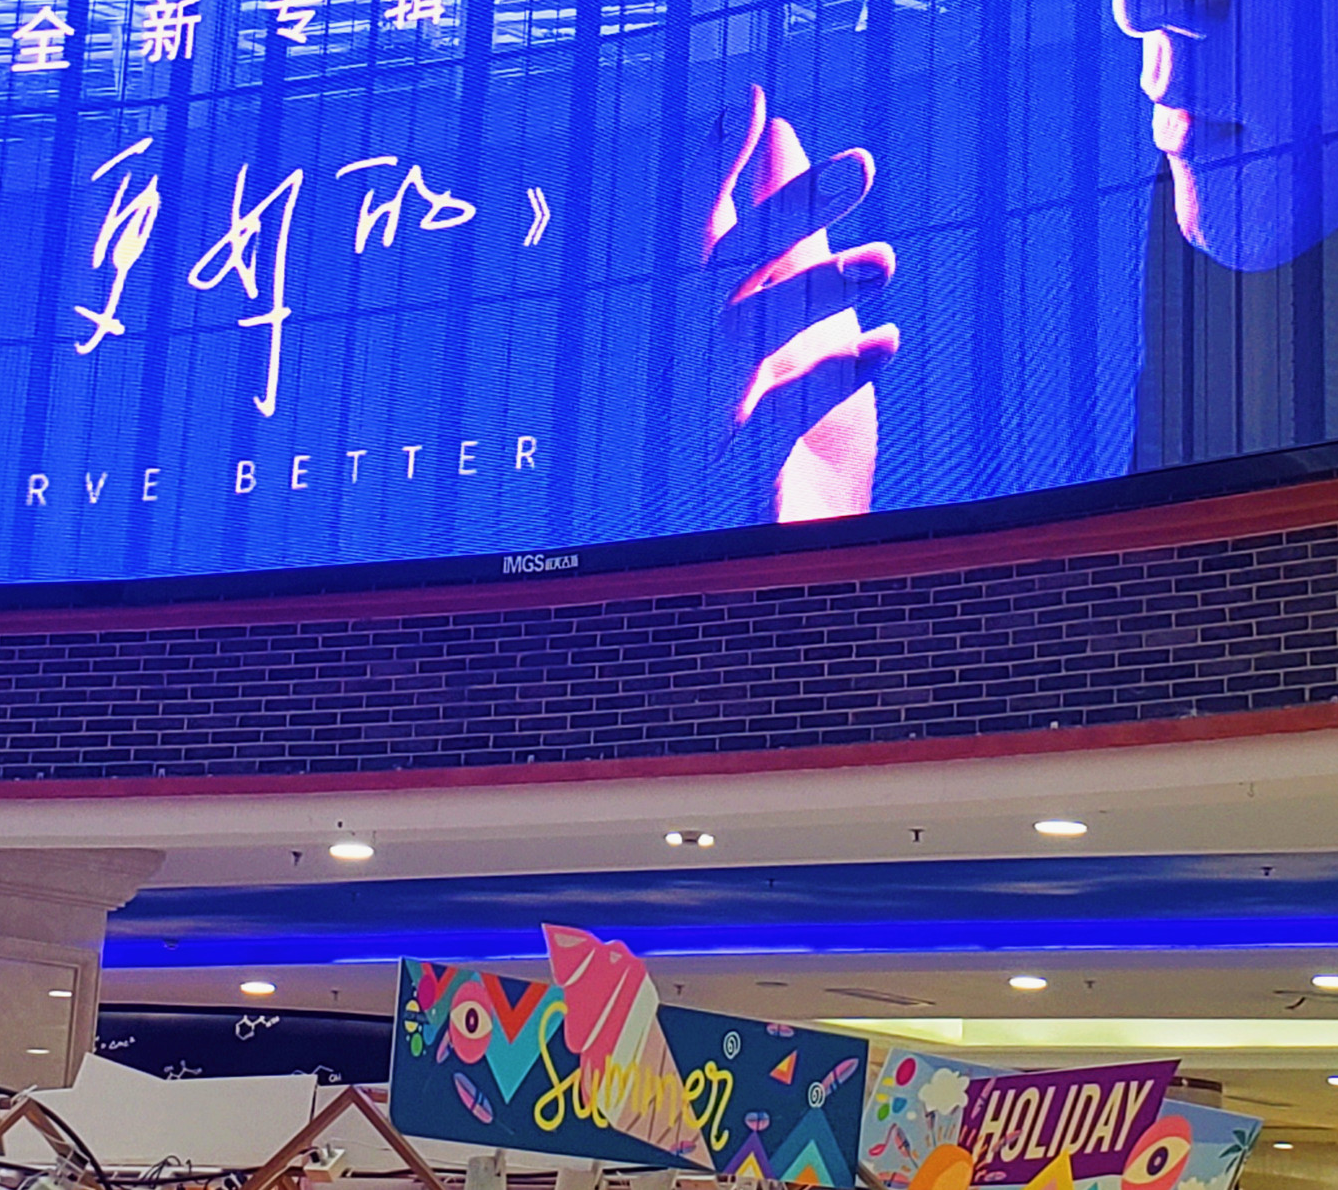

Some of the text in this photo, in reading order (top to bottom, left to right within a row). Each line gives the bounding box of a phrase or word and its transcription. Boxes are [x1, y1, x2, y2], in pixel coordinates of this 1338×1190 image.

[235, 434, 539, 494] BETTER
[534, 1001, 733, 1151] Summer
[977, 1078, 1155, 1165] HOLIDAY
